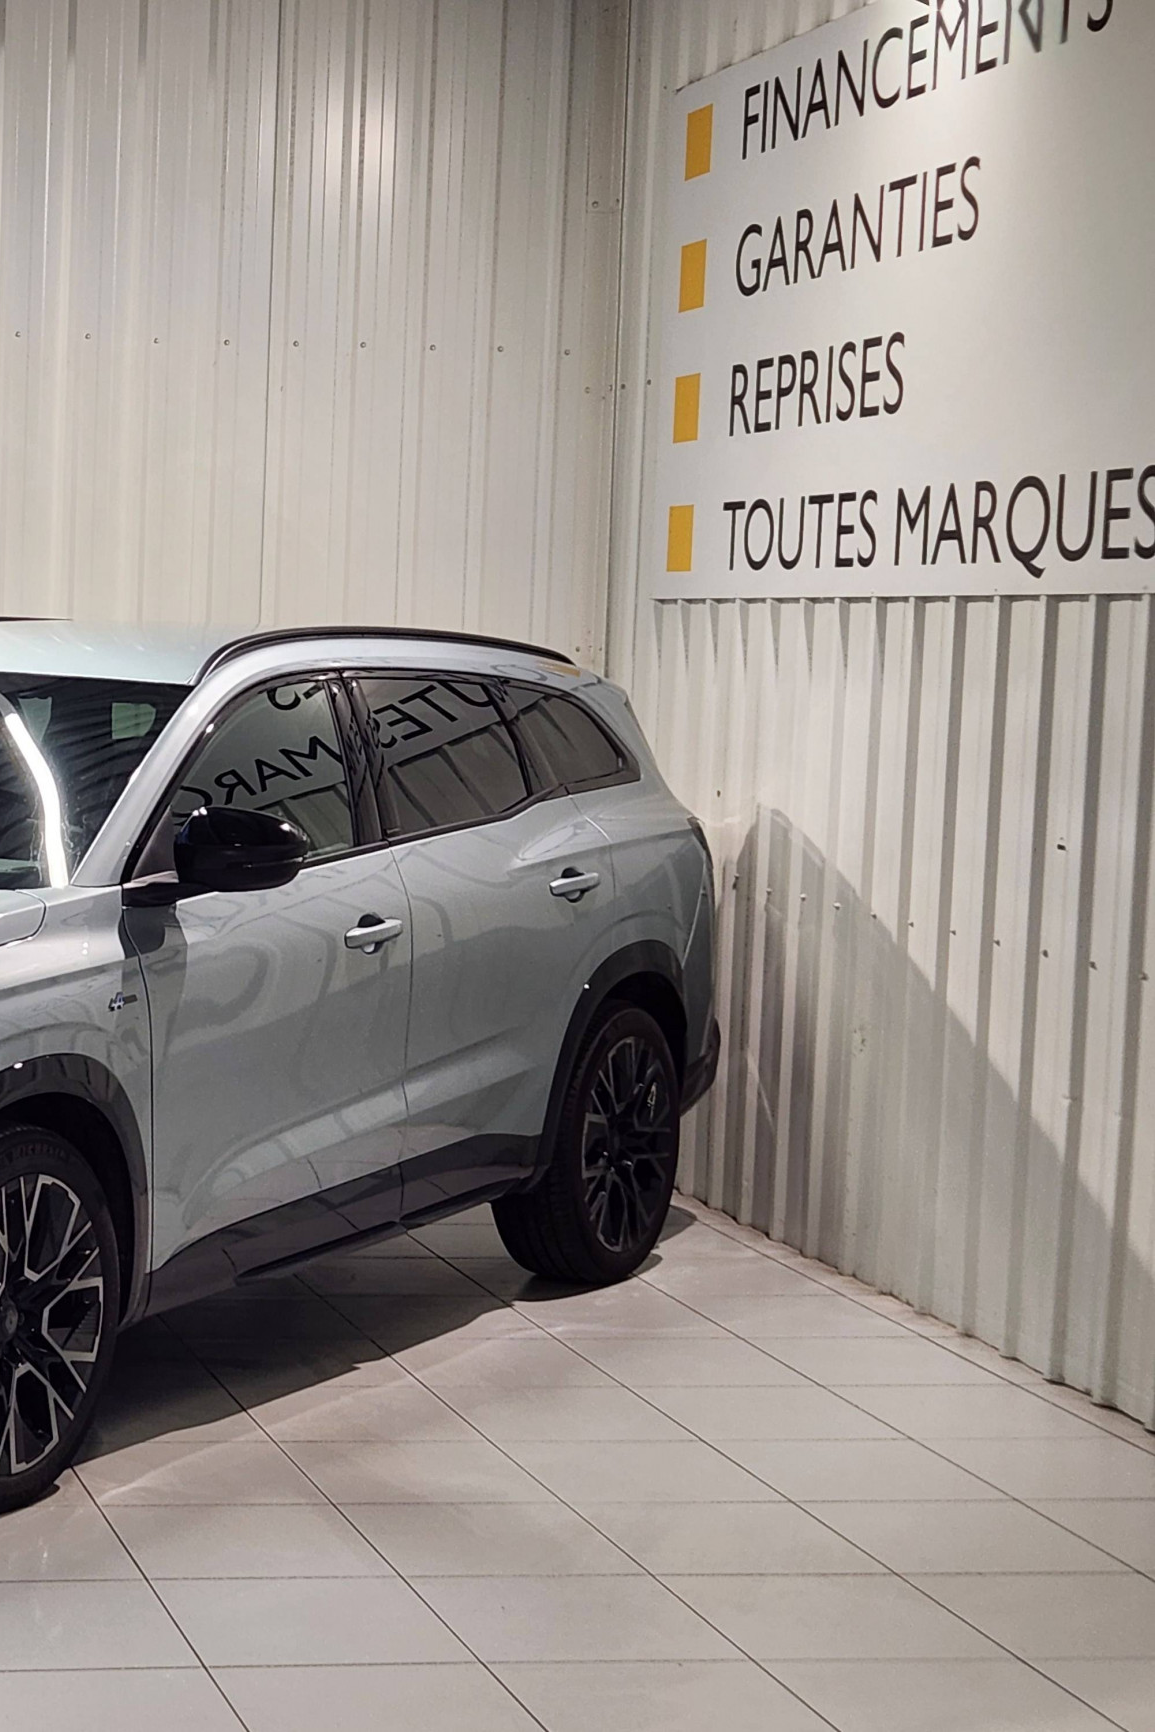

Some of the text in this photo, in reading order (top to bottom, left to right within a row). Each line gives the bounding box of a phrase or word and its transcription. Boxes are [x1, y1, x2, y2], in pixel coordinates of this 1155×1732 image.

[735, 156, 981, 297] GARANTIES
[729, 331, 905, 437] REPRISES
[722, 464, 1155, 579] TOUTES MARQUES
